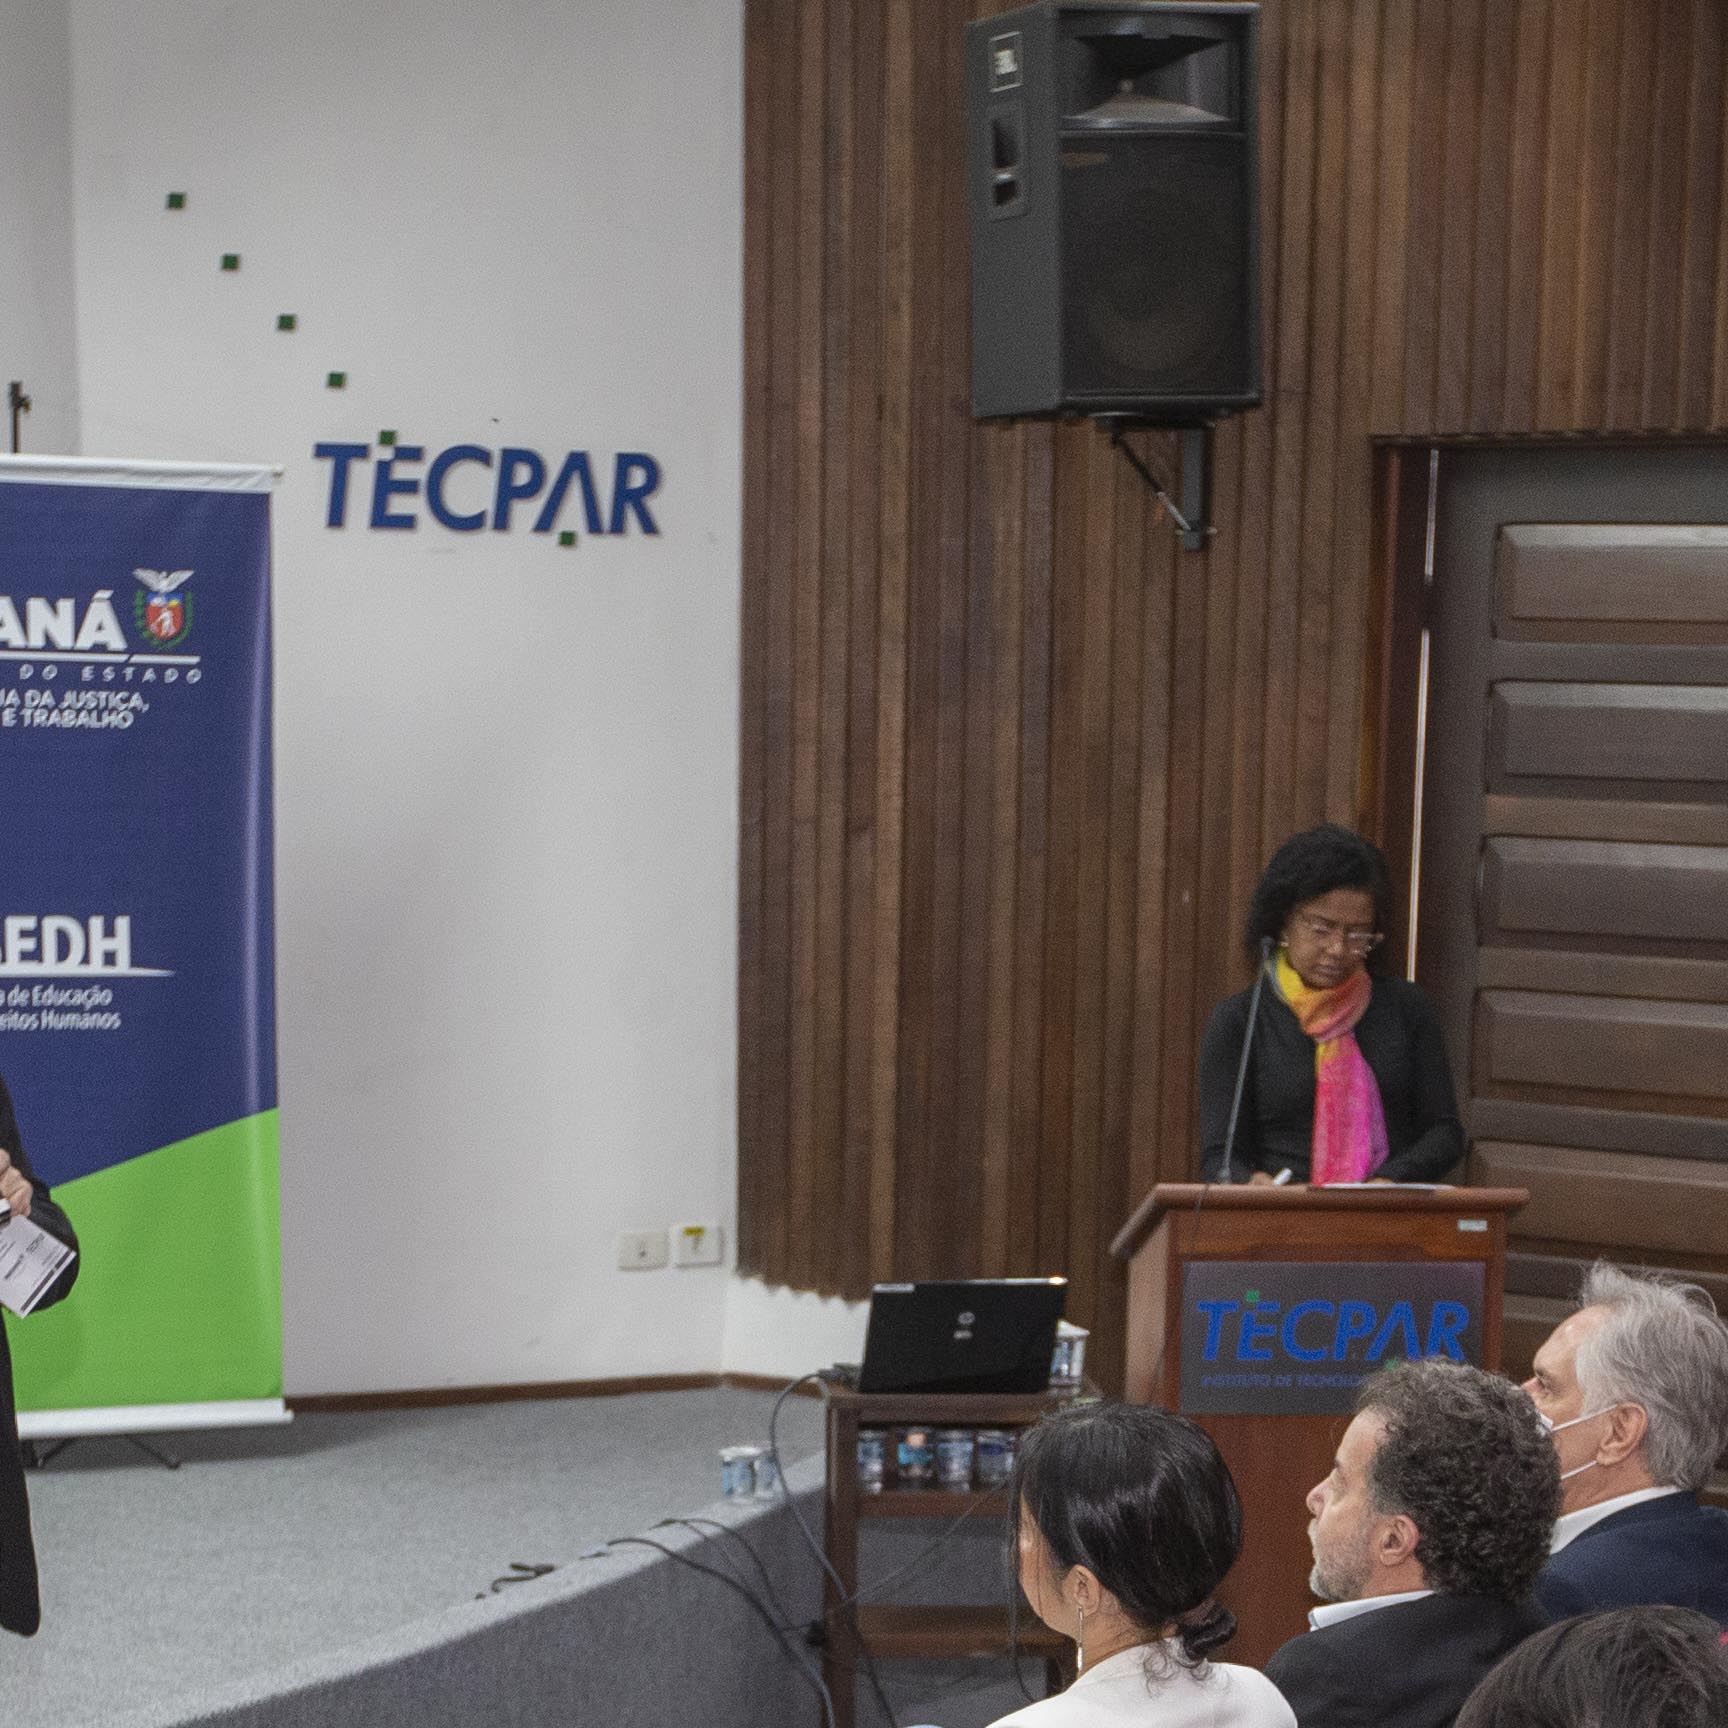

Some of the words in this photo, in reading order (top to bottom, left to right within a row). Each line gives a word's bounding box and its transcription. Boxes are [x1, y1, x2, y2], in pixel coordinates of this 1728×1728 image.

[314, 430, 663, 547] TECPAR
[20, 664, 58, 681] DO
[81, 666, 202, 684] ESTADO
[23, 690, 57, 707] DA
[2, 709, 18, 727] E
[21, 709, 134, 730] TRABALHO
[7, 984, 30, 1007] de
[31, 984, 113, 1012] Educação
[41, 1009, 121, 1030] Humanos
[1196, 1290, 1470, 1362] TECPAR
